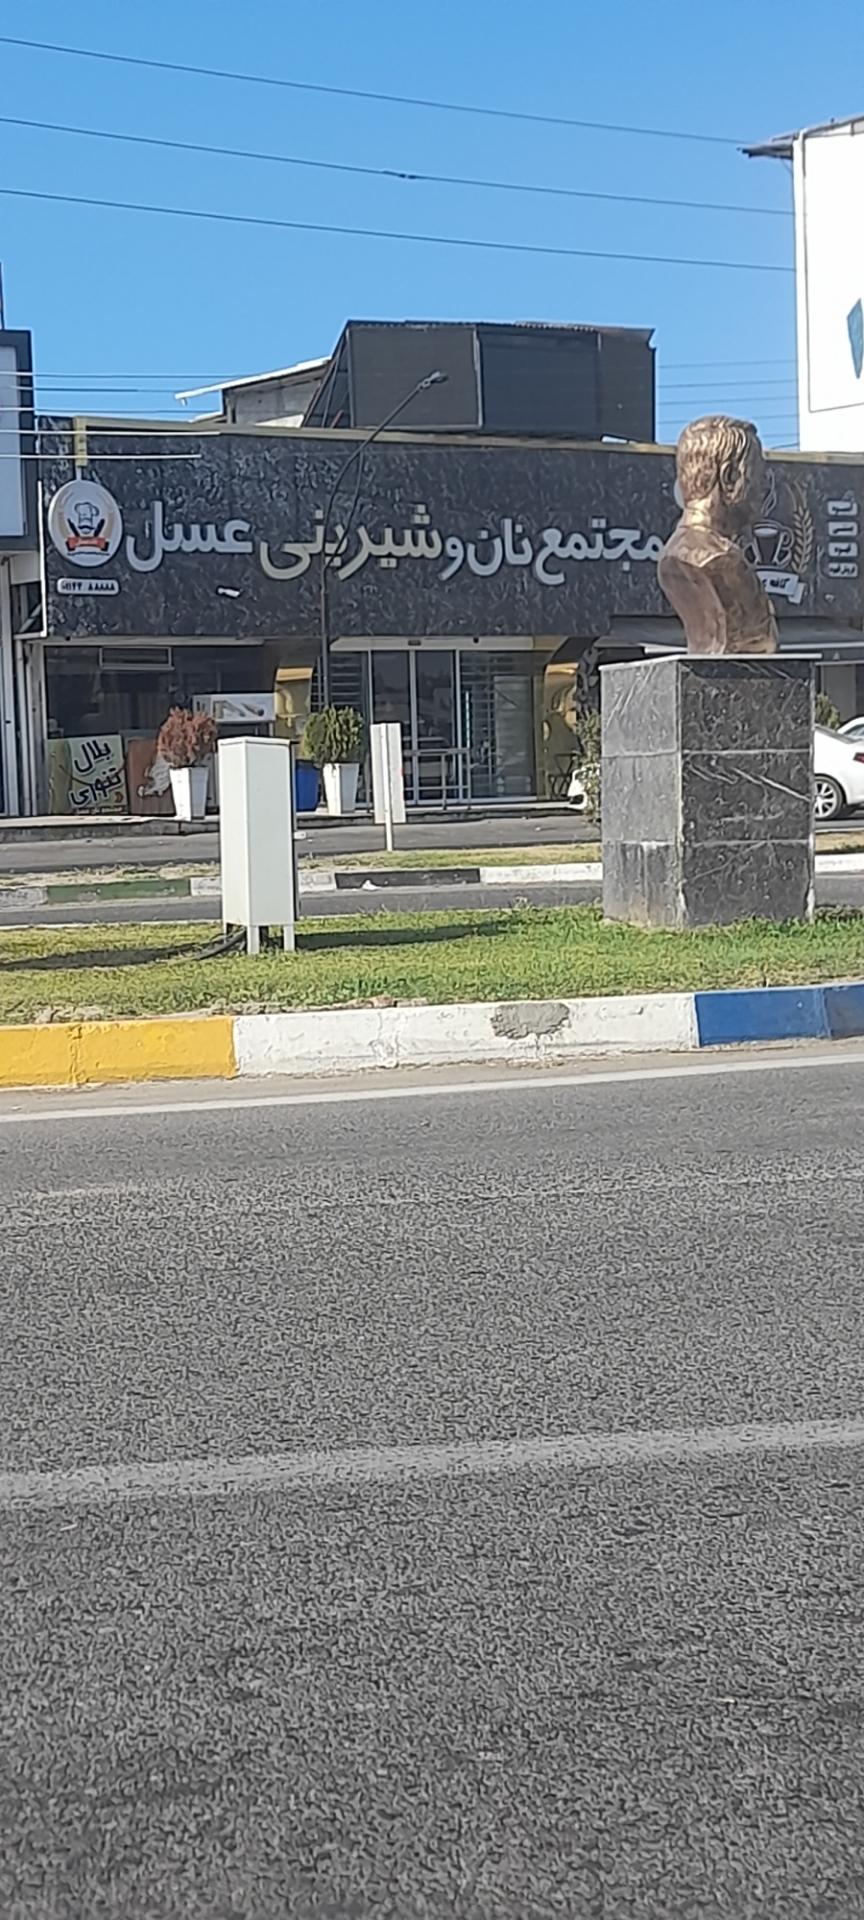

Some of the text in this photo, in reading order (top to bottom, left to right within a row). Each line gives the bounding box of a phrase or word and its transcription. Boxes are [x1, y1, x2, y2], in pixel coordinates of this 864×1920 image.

[126, 500, 665, 585] مجتمع نان و شیرینی عسل
[74, 740, 111, 773] بلال
[70, 767, 121, 805] تنوری
